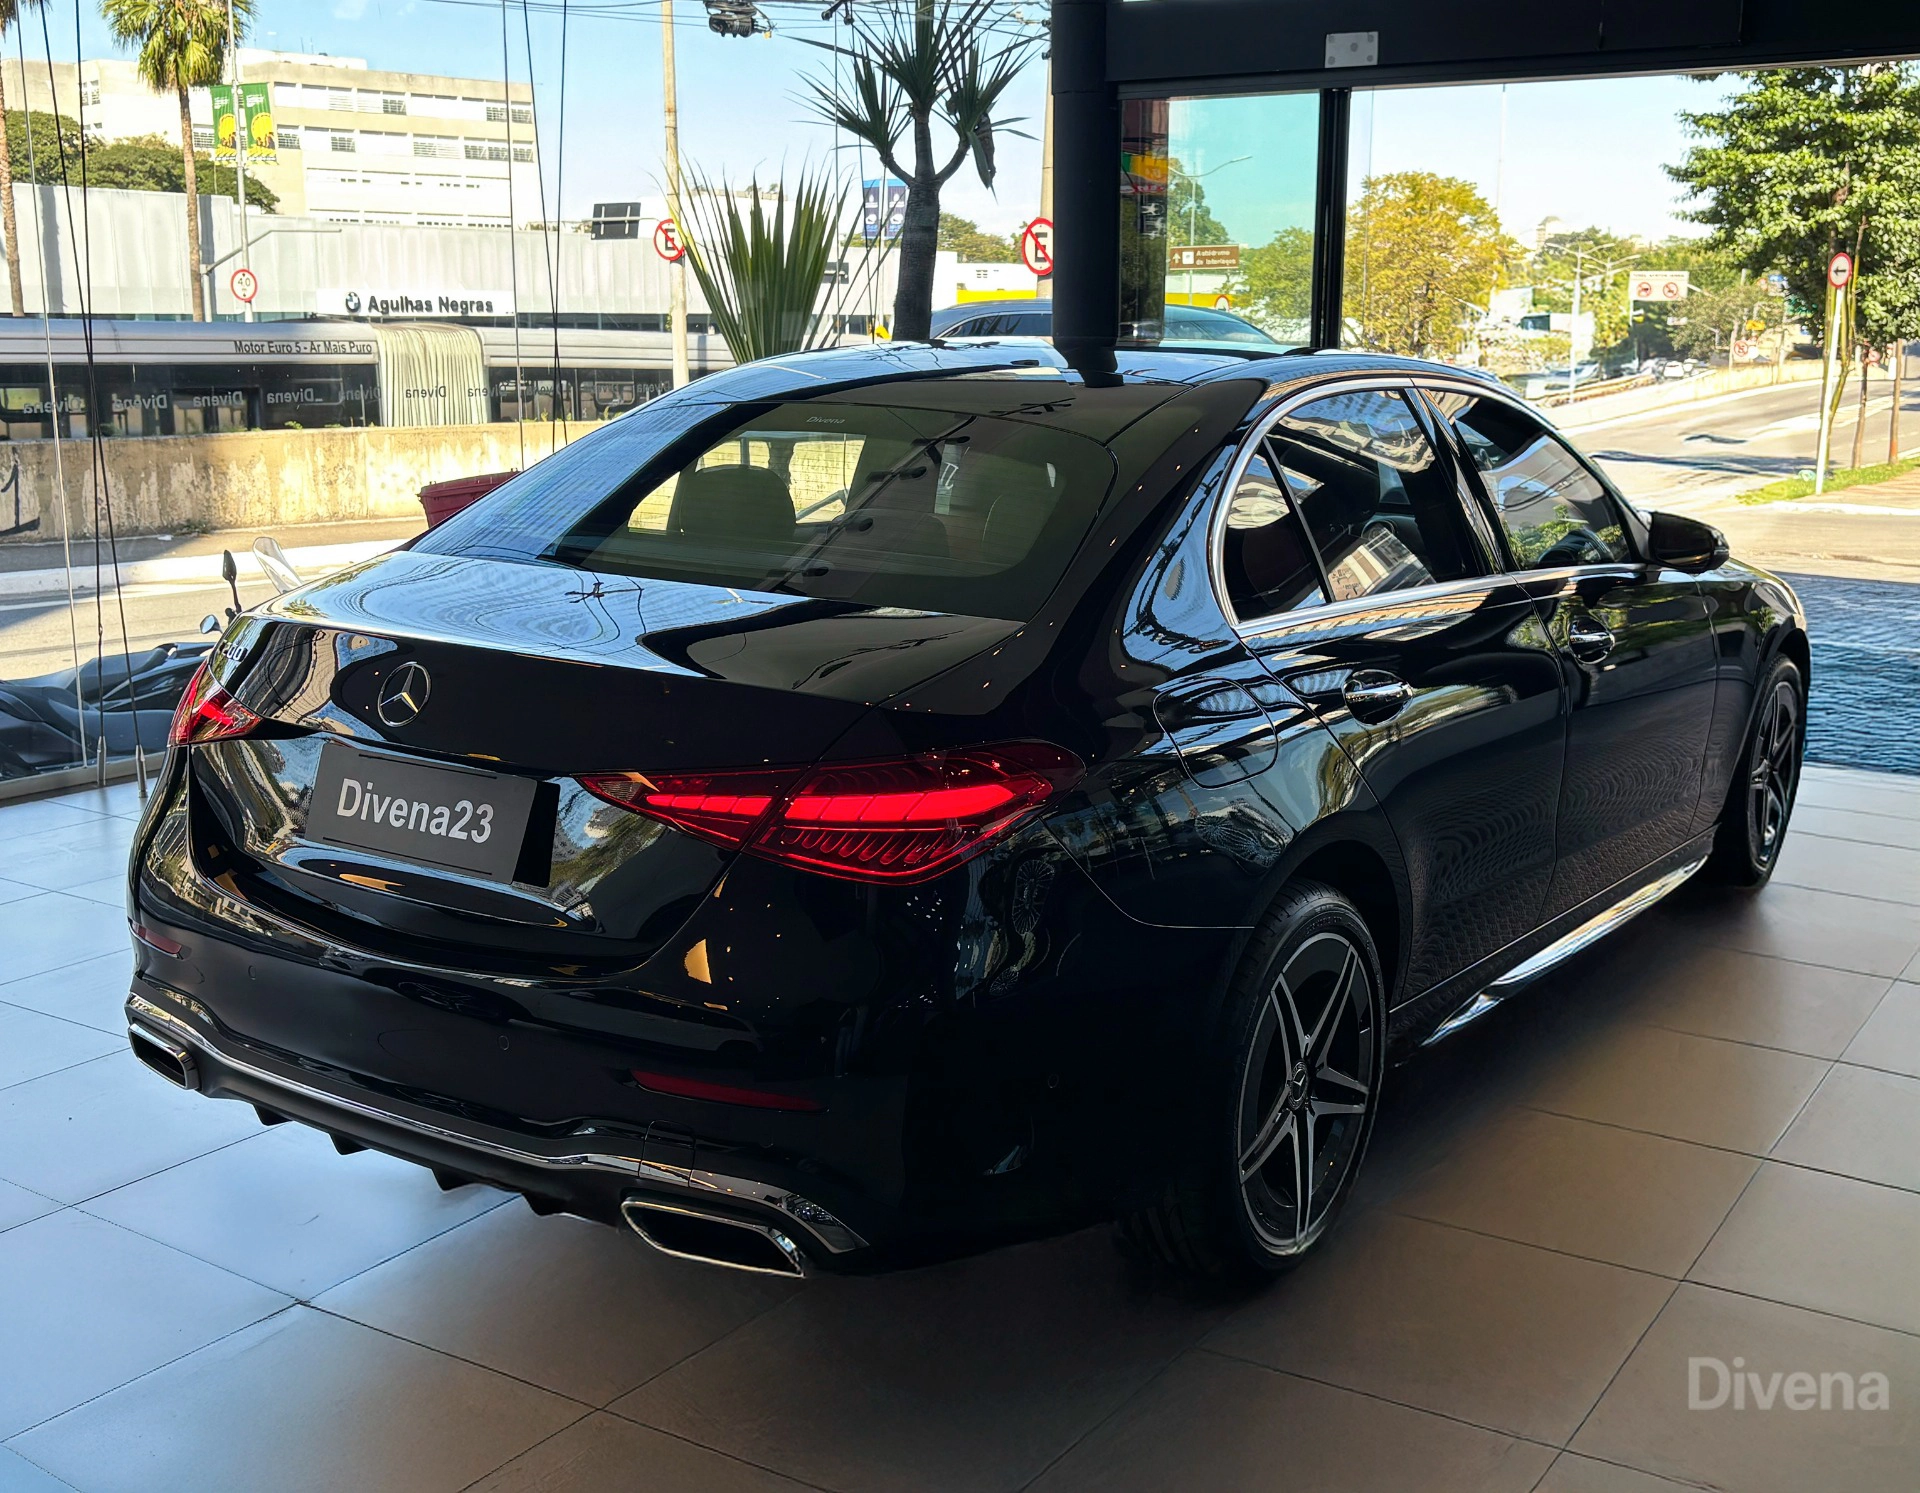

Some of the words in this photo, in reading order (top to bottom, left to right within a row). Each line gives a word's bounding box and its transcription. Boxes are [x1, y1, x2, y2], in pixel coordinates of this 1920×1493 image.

[368, 295, 433, 315] Agulhas
[438, 296, 493, 316] Negras
[234, 340, 265, 354] Motor
[267, 340, 293, 354] Euro
[294, 341, 302, 354] 5
[309, 340, 321, 354] Ar
[323, 340, 346, 354] Mais
[348, 340, 372, 354] Puro
[336, 777, 494, 844] Divena23
